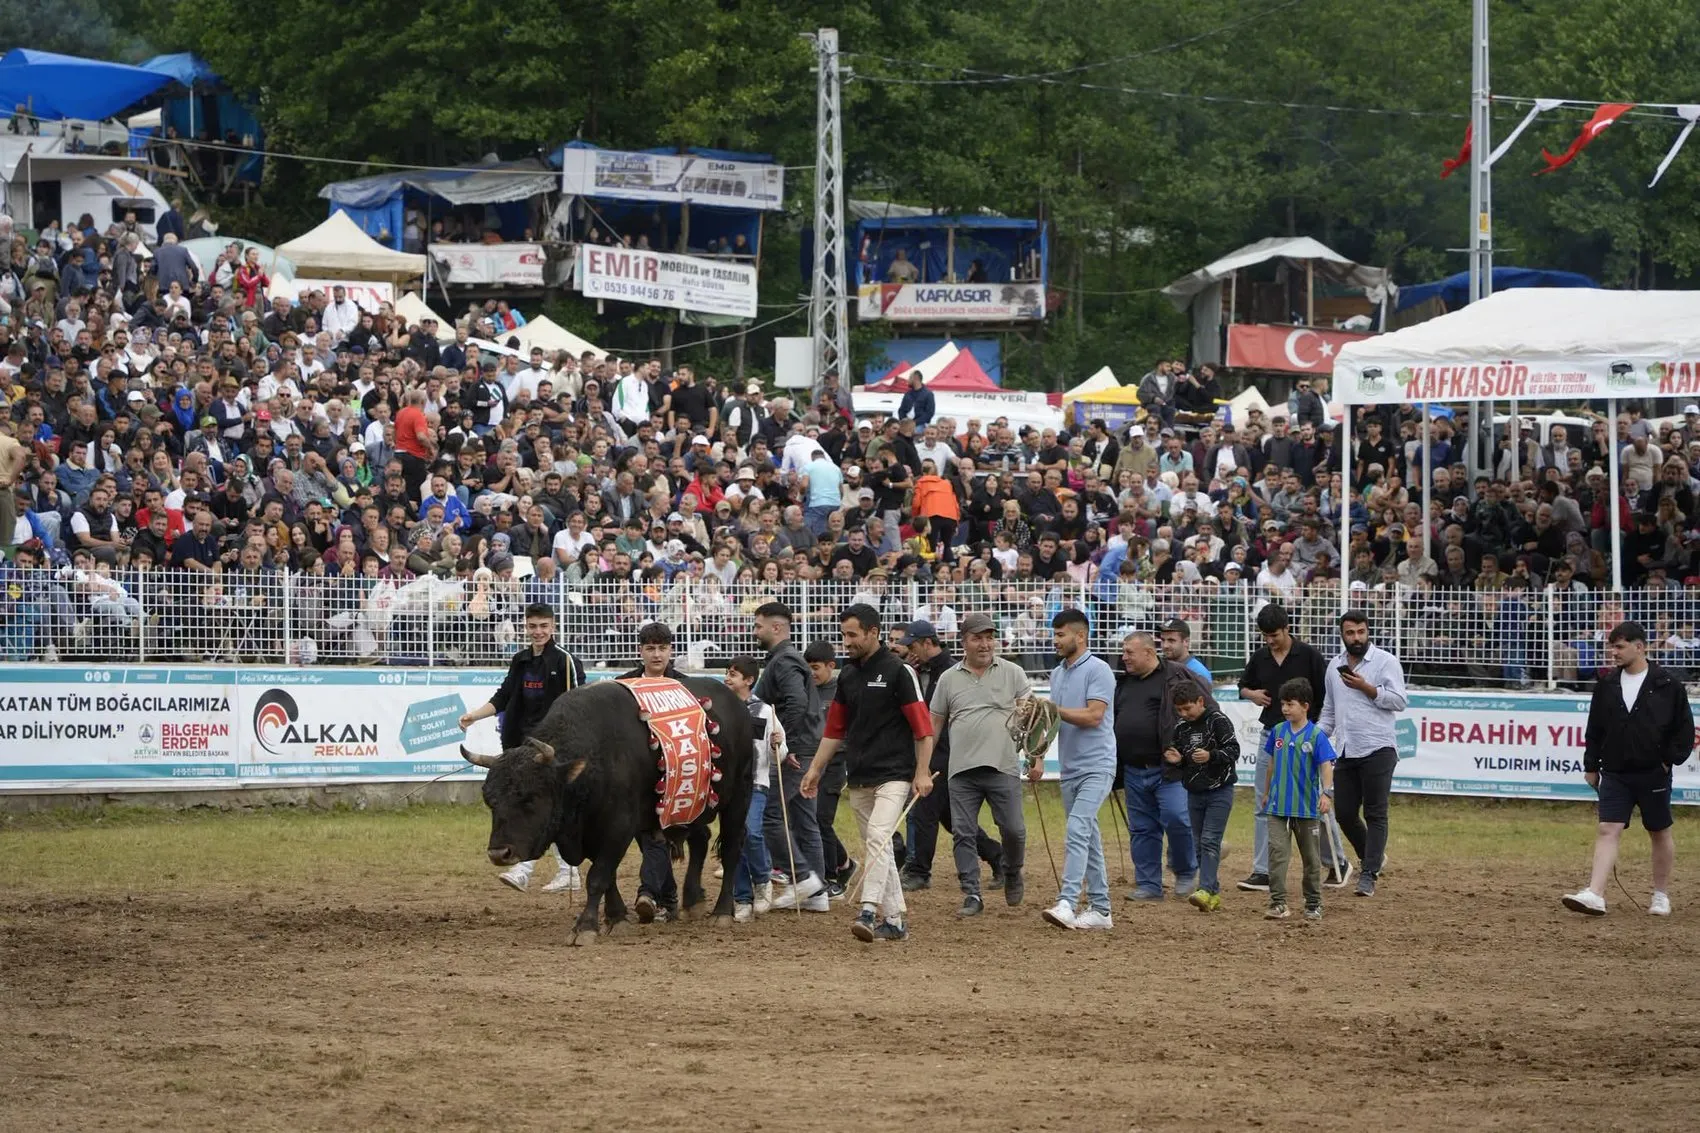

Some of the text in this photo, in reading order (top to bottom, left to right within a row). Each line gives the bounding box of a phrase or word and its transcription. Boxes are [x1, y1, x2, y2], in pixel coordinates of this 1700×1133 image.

[604, 282, 627, 294] 0535
[1406, 360, 1528, 399] KAFKASÖR
[58, 693, 91, 712] TÜM
[96, 693, 231, 712] BOĞACILARIMIZA
[280, 724, 378, 744] ALKAN
[1421, 716, 1537, 746] İBRAHİM
[162, 737, 208, 750] ERDEM
[314, 745, 379, 756] REKLAM
[666, 717, 698, 815] KASAP
[1474, 756, 1585, 774] YILDIRIM İNŞA
